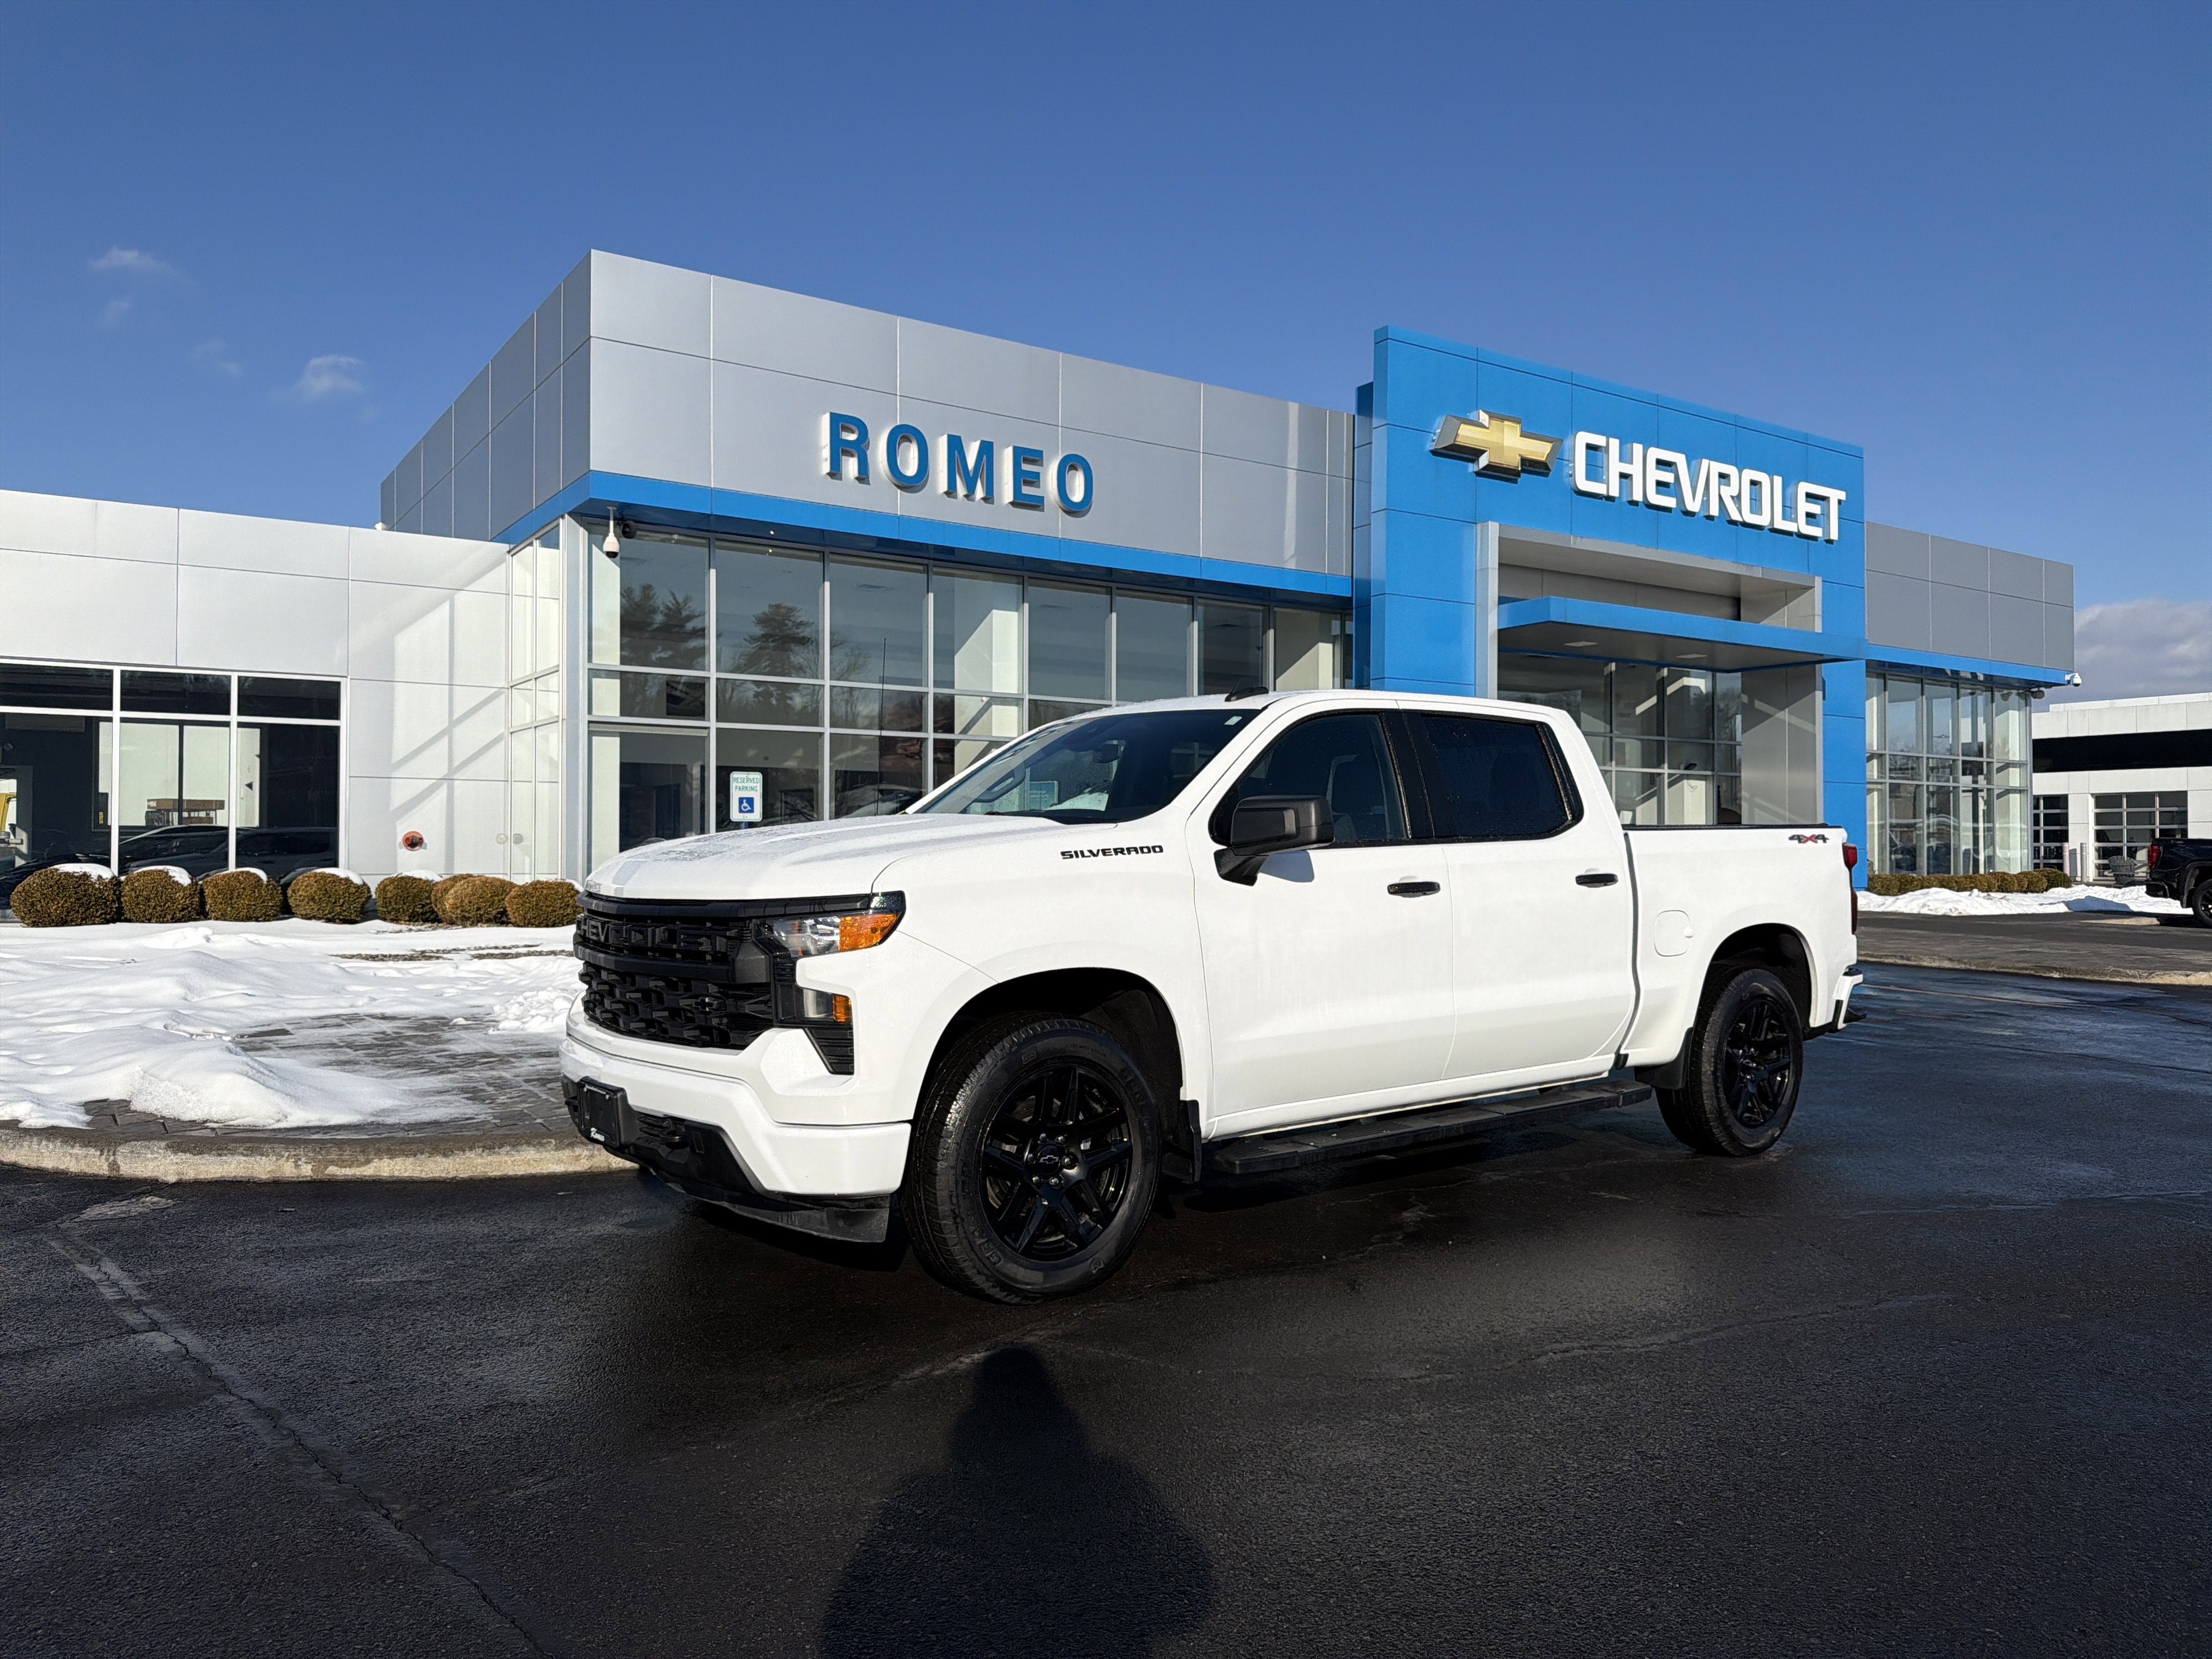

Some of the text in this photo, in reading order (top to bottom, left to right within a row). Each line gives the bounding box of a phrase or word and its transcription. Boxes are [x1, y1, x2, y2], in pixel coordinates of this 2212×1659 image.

[825, 411, 1093, 513] ROMEO
[1574, 431, 1846, 541] CHEVROLET
[1060, 845, 1164, 860] SILVERADO
